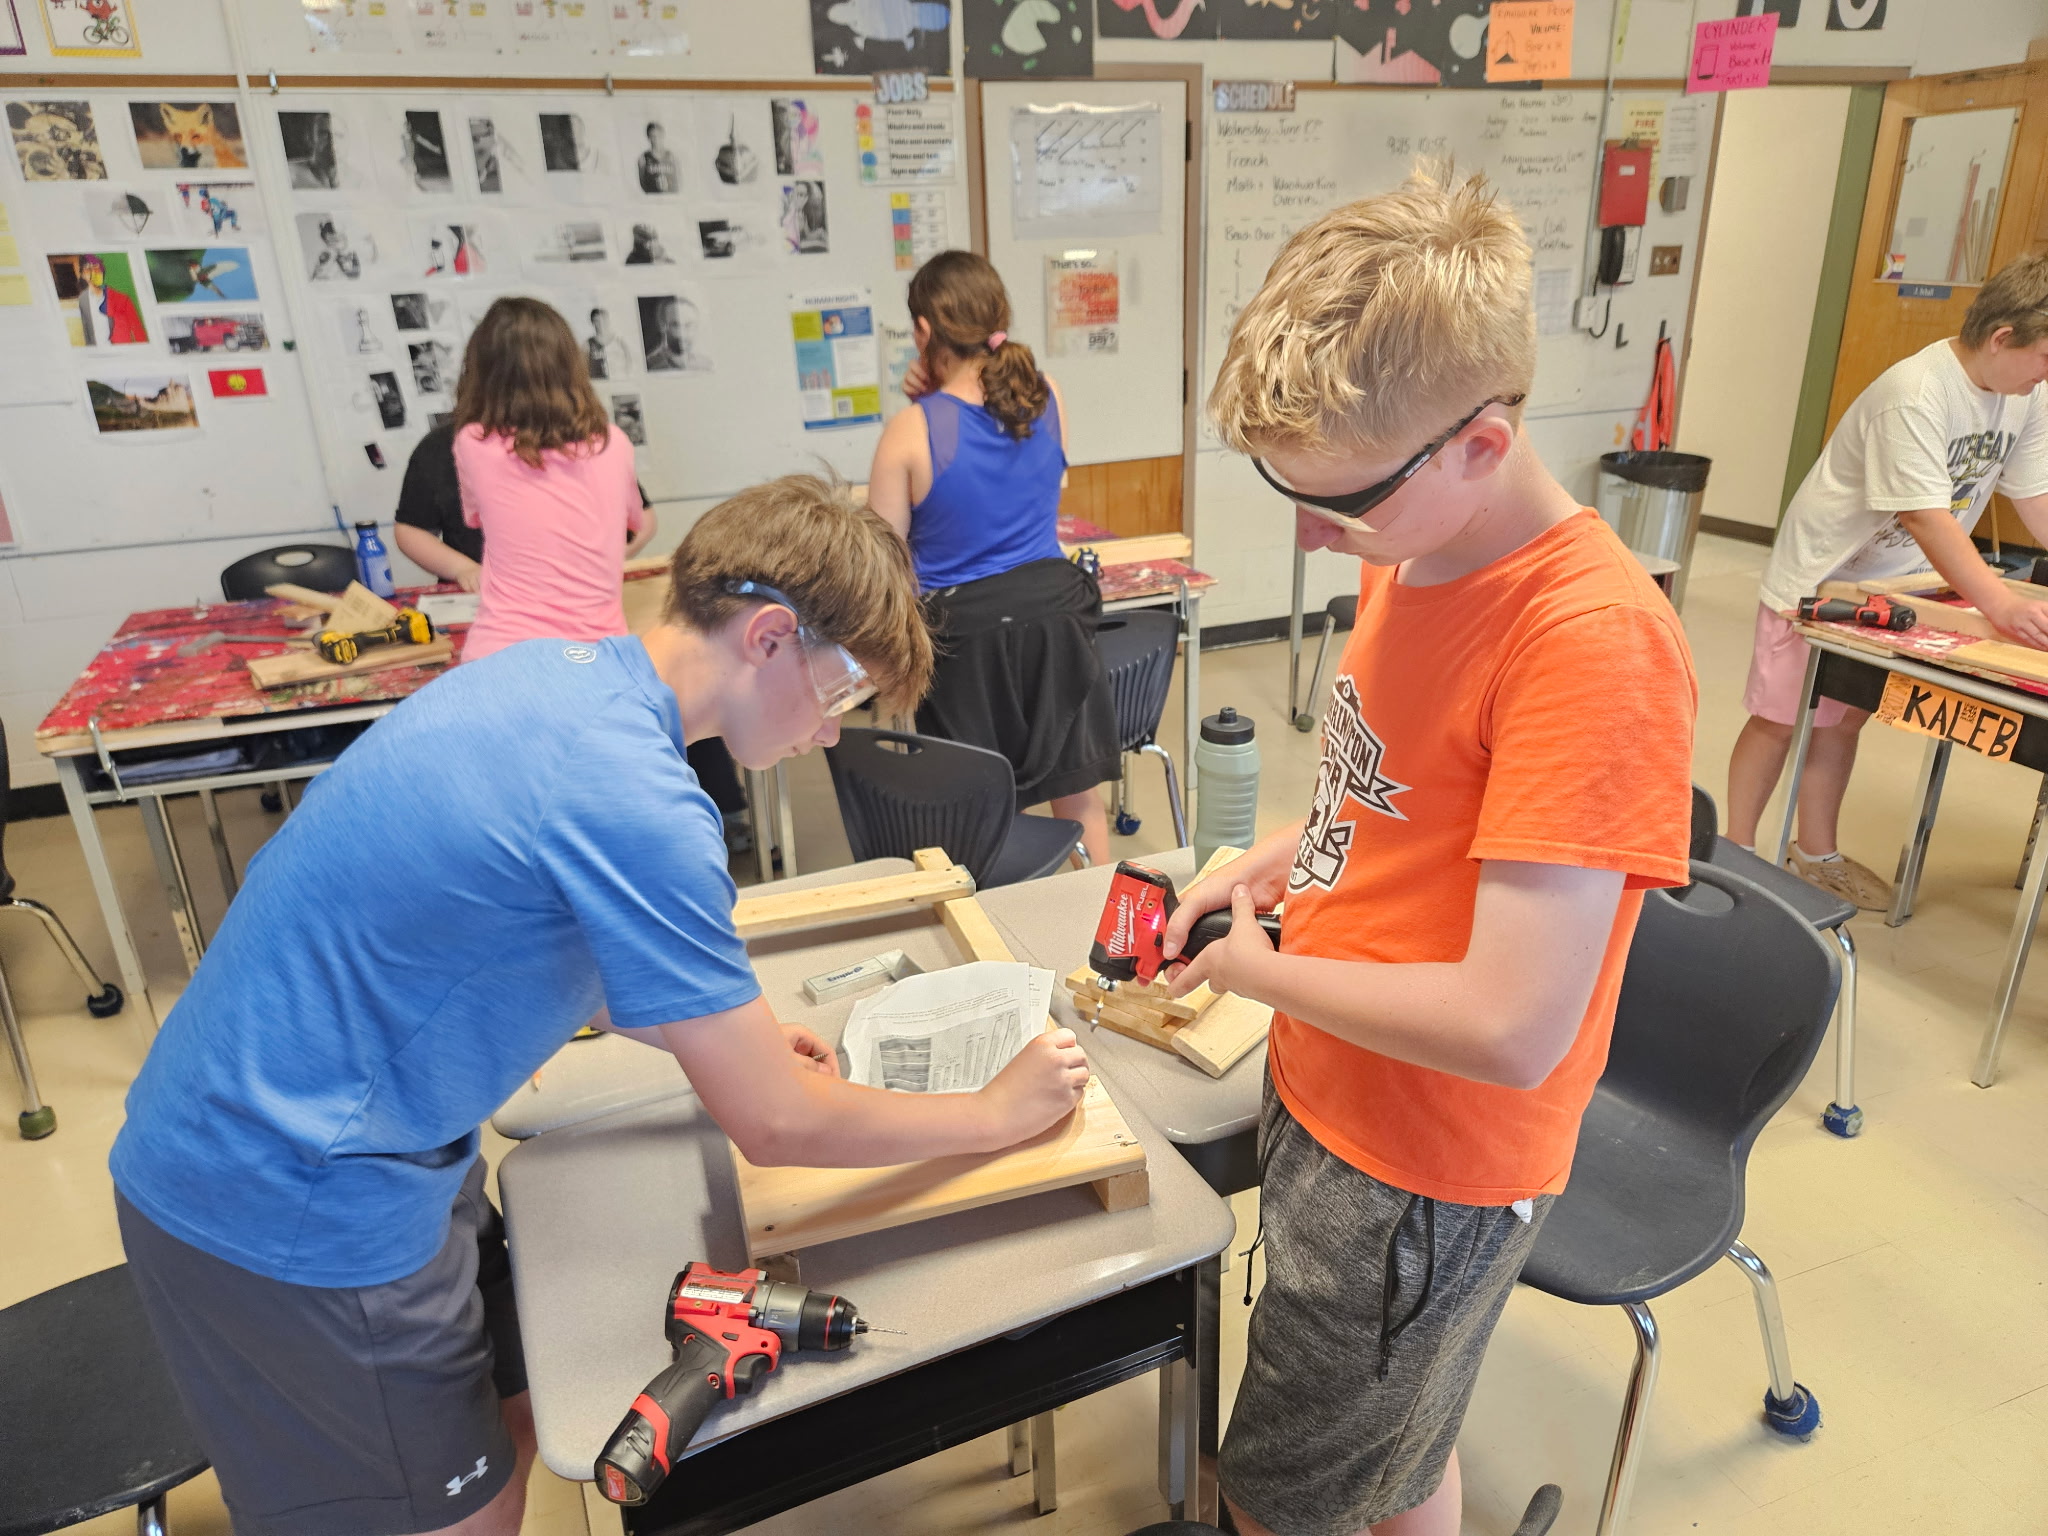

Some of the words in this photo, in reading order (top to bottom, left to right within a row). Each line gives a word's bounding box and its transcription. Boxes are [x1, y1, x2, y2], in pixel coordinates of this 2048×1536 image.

[1704, 15, 1770, 39] CYLINDER
[878, 72, 928, 103] JOBS
[1215, 82, 1295, 111] SCHEDULE
[1902, 685, 2018, 757] KALEB
[1136, 884, 1150, 911] FUEL
[1108, 893, 1129, 955] Milwaukee
